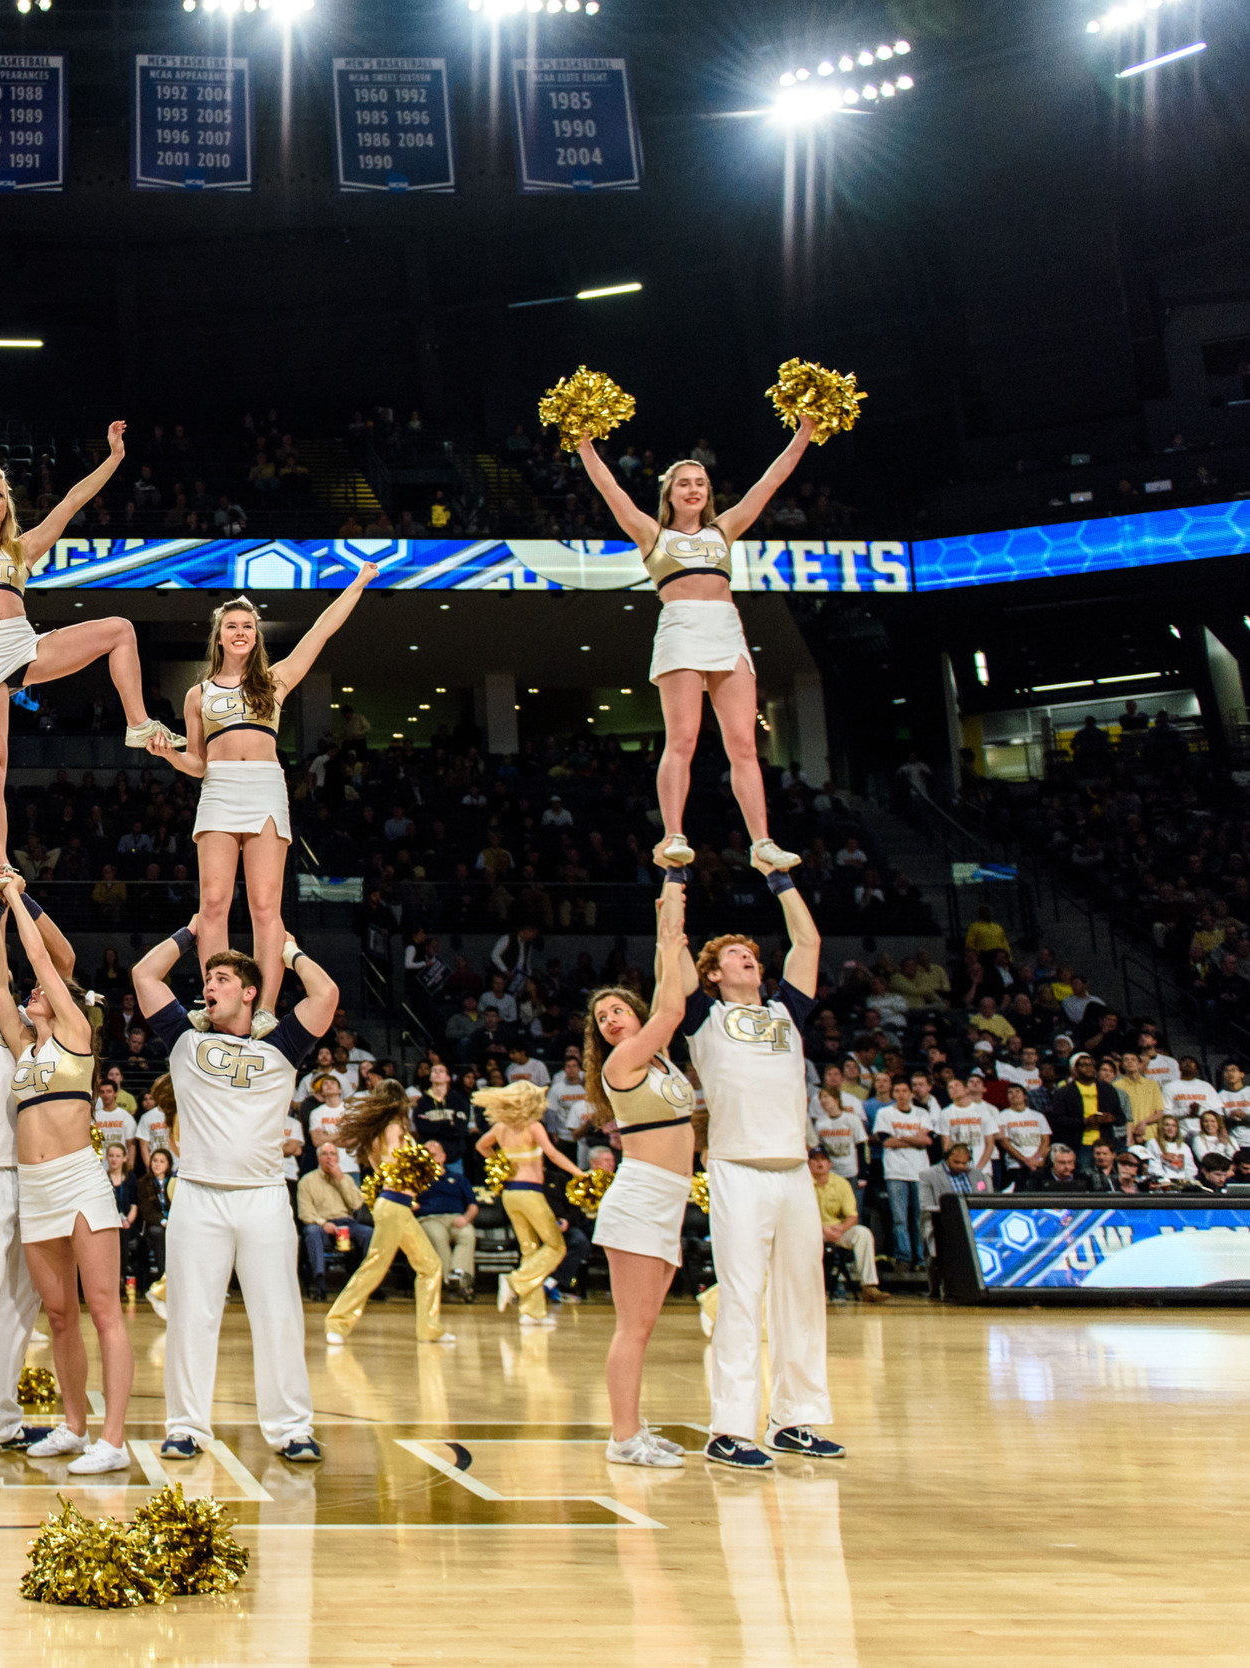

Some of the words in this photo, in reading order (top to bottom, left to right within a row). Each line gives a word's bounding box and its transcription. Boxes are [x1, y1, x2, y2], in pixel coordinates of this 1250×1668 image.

[150, 70, 172, 79] NCAA
[175, 71, 236, 81] APPEARANCES
[10, 86, 43, 101] 1988
[156, 85, 188, 100] 1992
[196, 87, 233, 101] 2004
[354, 88, 388, 103] 1960
[395, 88, 427, 103] 1992
[549, 92, 592, 110] 1985
[10, 108, 43, 123] 1989
[156, 107, 188, 122] 1993
[197, 109, 232, 124] 2005
[355, 110, 388, 125] 1985
[396, 110, 430, 125] 1996
[553, 120, 596, 138] 1990
[10, 131, 43, 145] 1990
[156, 129, 190, 144] 1996
[197, 131, 232, 146] 2007
[357, 133, 391, 147] 1986
[398, 133, 434, 147] 2004
[9, 153, 40, 168] 1991
[156, 151, 190, 166] 2001
[197, 153, 230, 168] 2010
[359, 155, 393, 169] 1990
[557, 148, 603, 166] 2004
[667, 536, 728, 564] GT
[724, 1007, 792, 1052] GT
[196, 1038, 265, 1088] GT
[11, 1061, 56, 1093] GT
[151, 1121, 168, 1131] ORA
